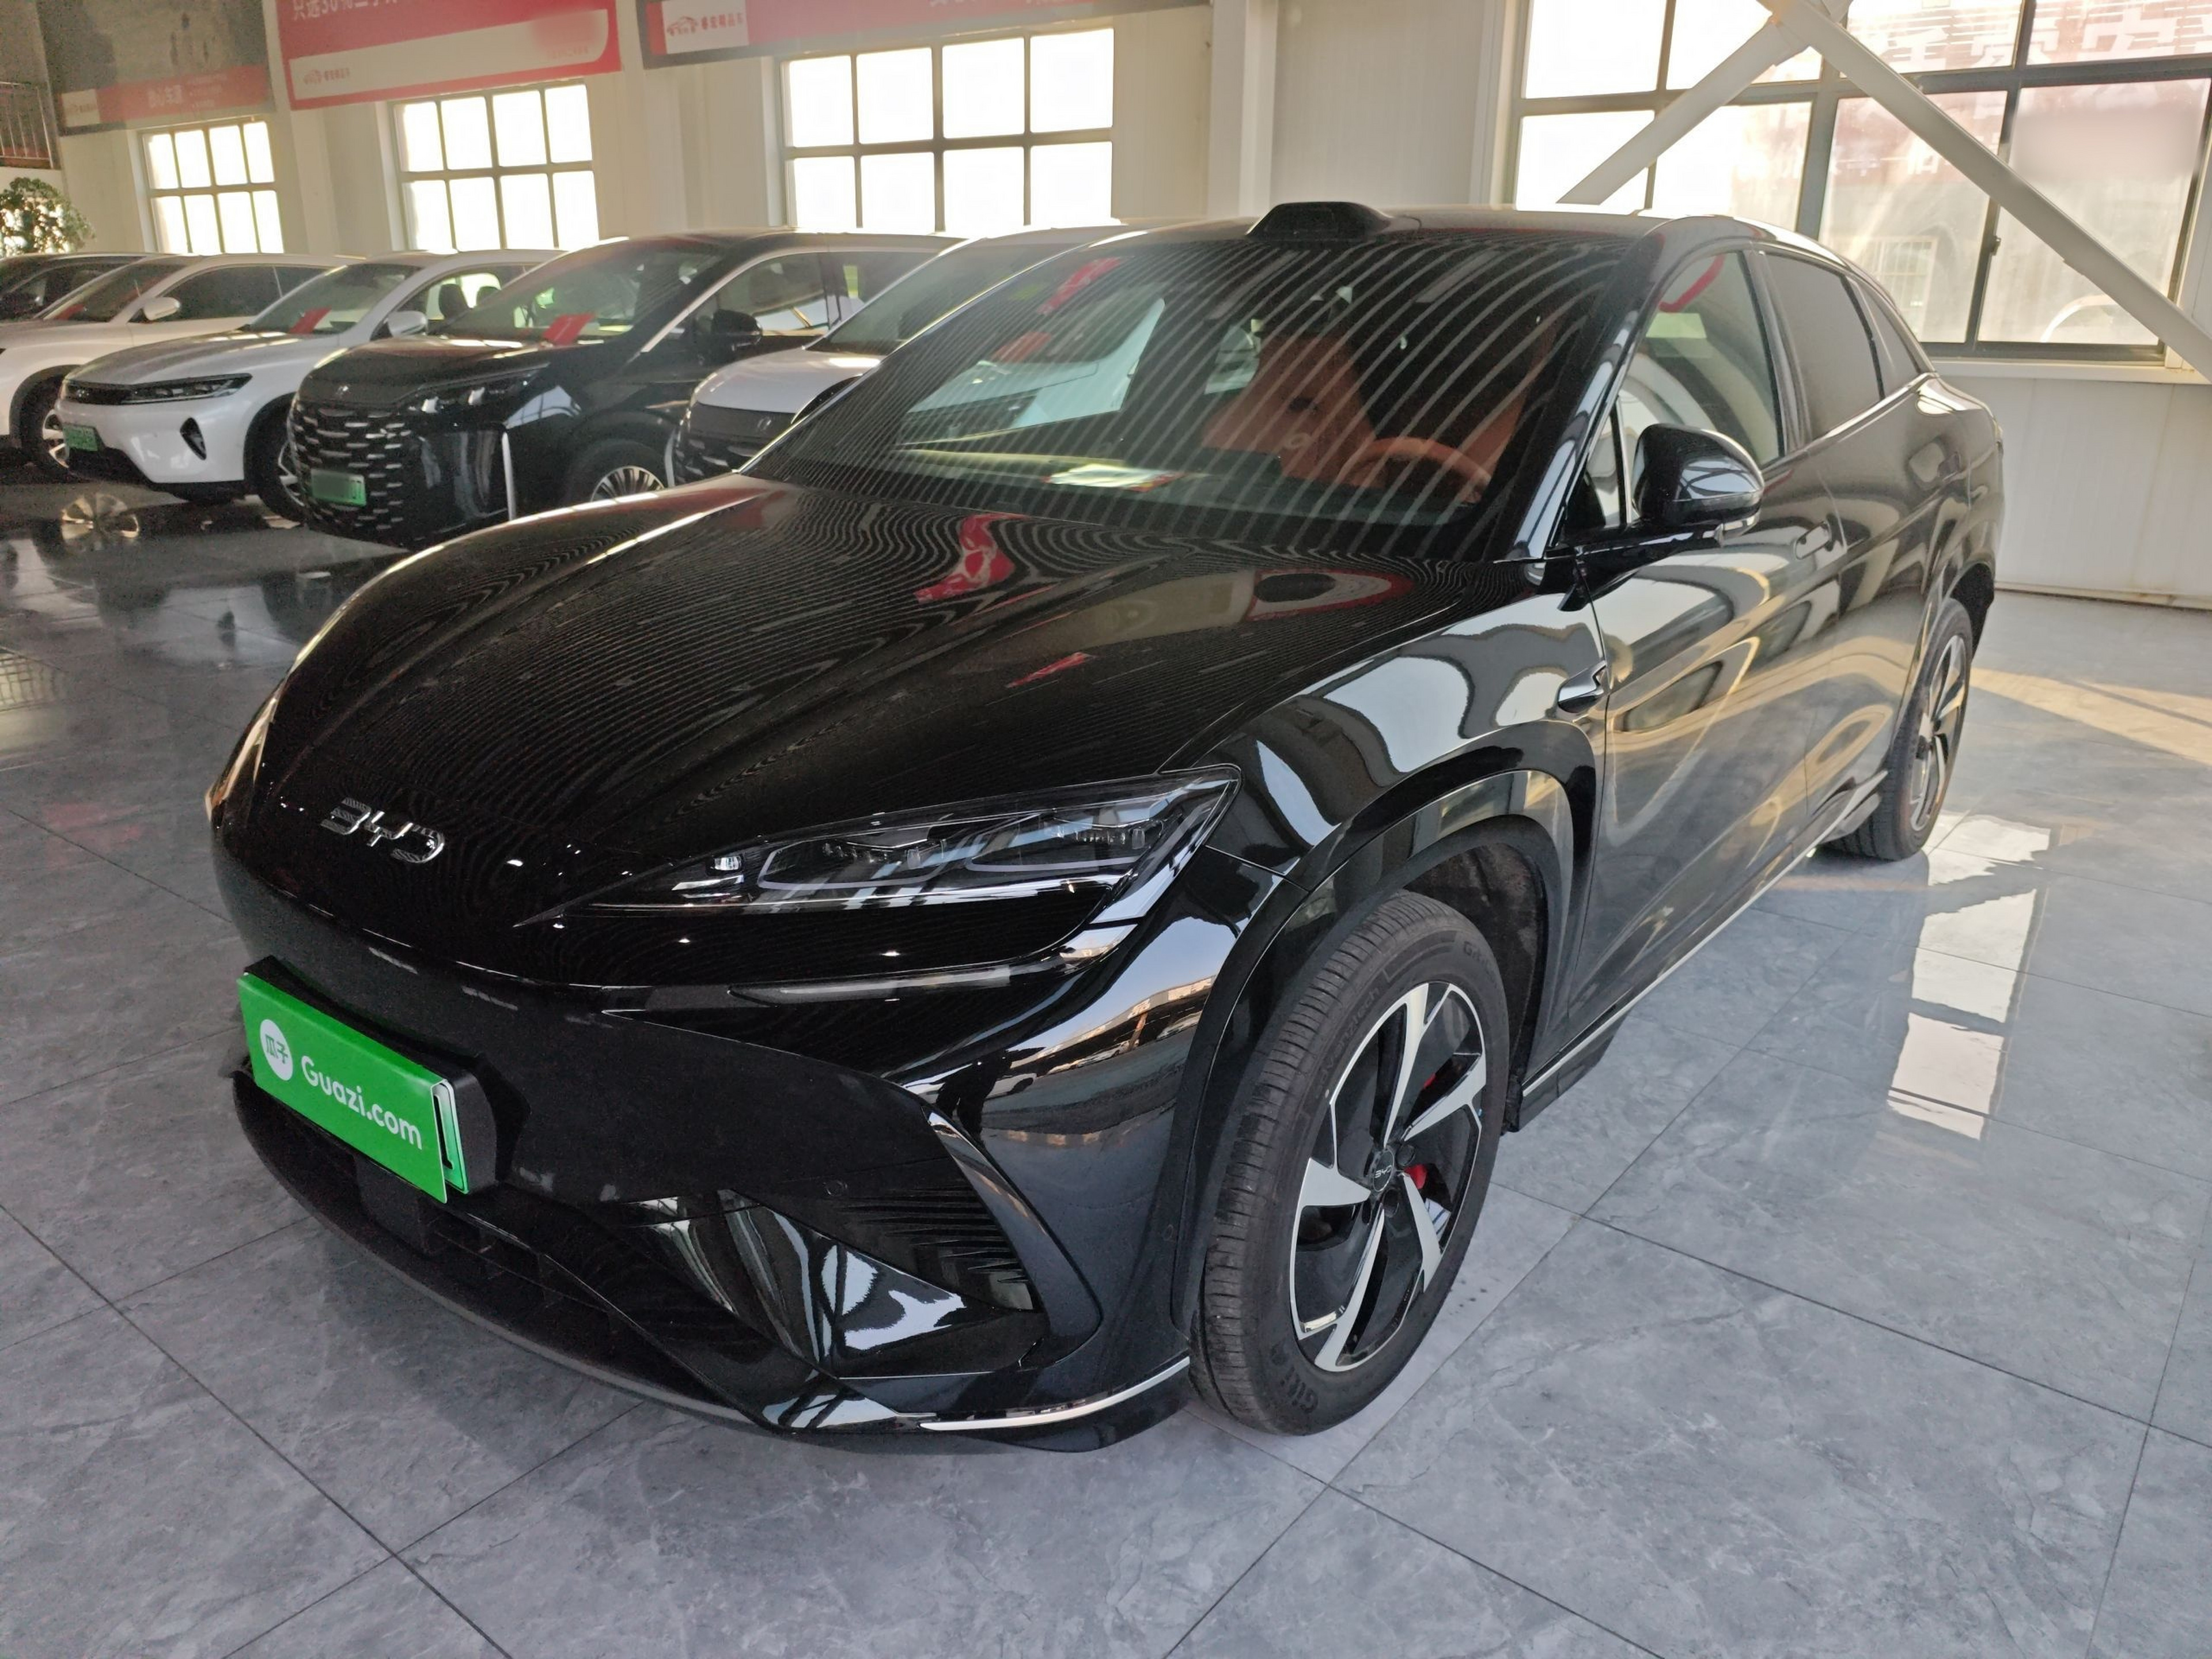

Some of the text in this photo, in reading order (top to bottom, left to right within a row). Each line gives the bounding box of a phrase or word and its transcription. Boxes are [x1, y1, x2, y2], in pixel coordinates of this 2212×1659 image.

[320, 797, 445, 863] BYD
[265, 1033, 289, 1065] 瓜子
[301, 1055, 422, 1150] Guazi.com
[1374, 1164, 1392, 1179] BYD
